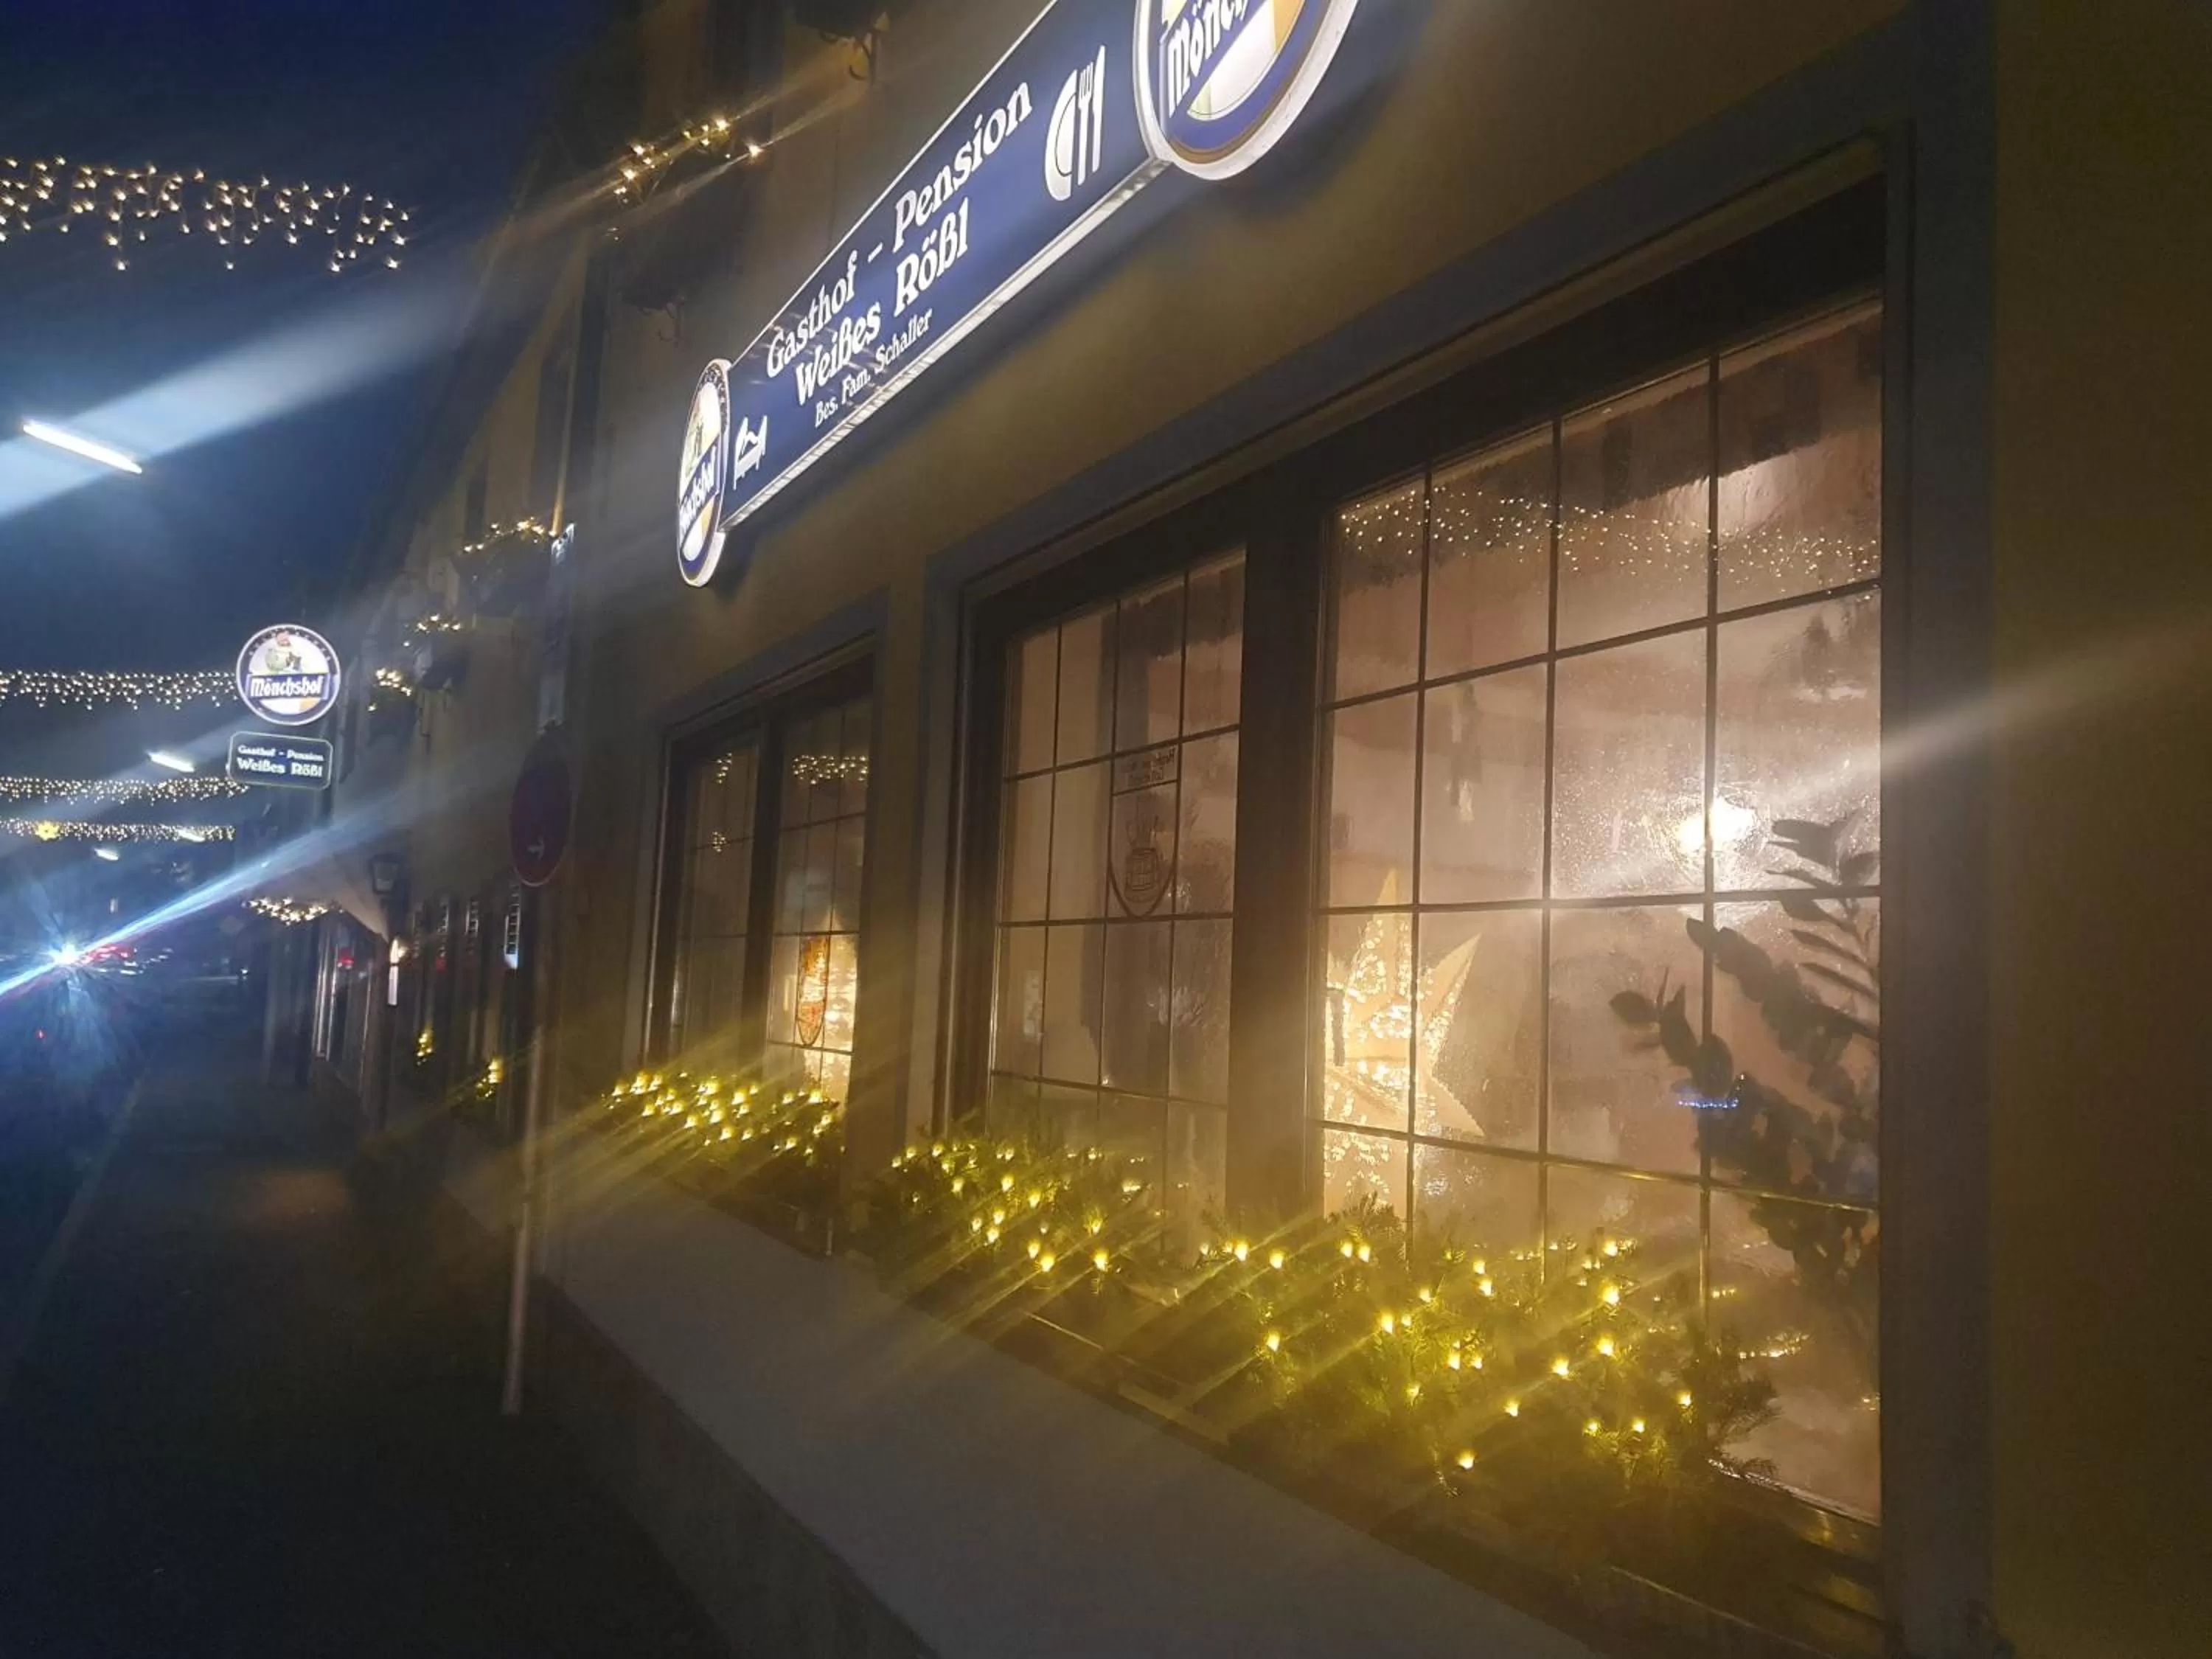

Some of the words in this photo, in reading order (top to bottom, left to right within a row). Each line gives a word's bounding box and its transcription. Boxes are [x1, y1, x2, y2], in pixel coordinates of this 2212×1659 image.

[767, 250, 857, 378] Gasthof
[892, 82, 1032, 253] Pension
[796, 302, 880, 406] Weißes
[894, 196, 969, 317] Rößl
[815, 397, 838, 428] Bes.
[841, 369, 871, 404] Fam.
[874, 308, 933, 374] Schaller
[251, 675, 324, 698] Mönchshof
